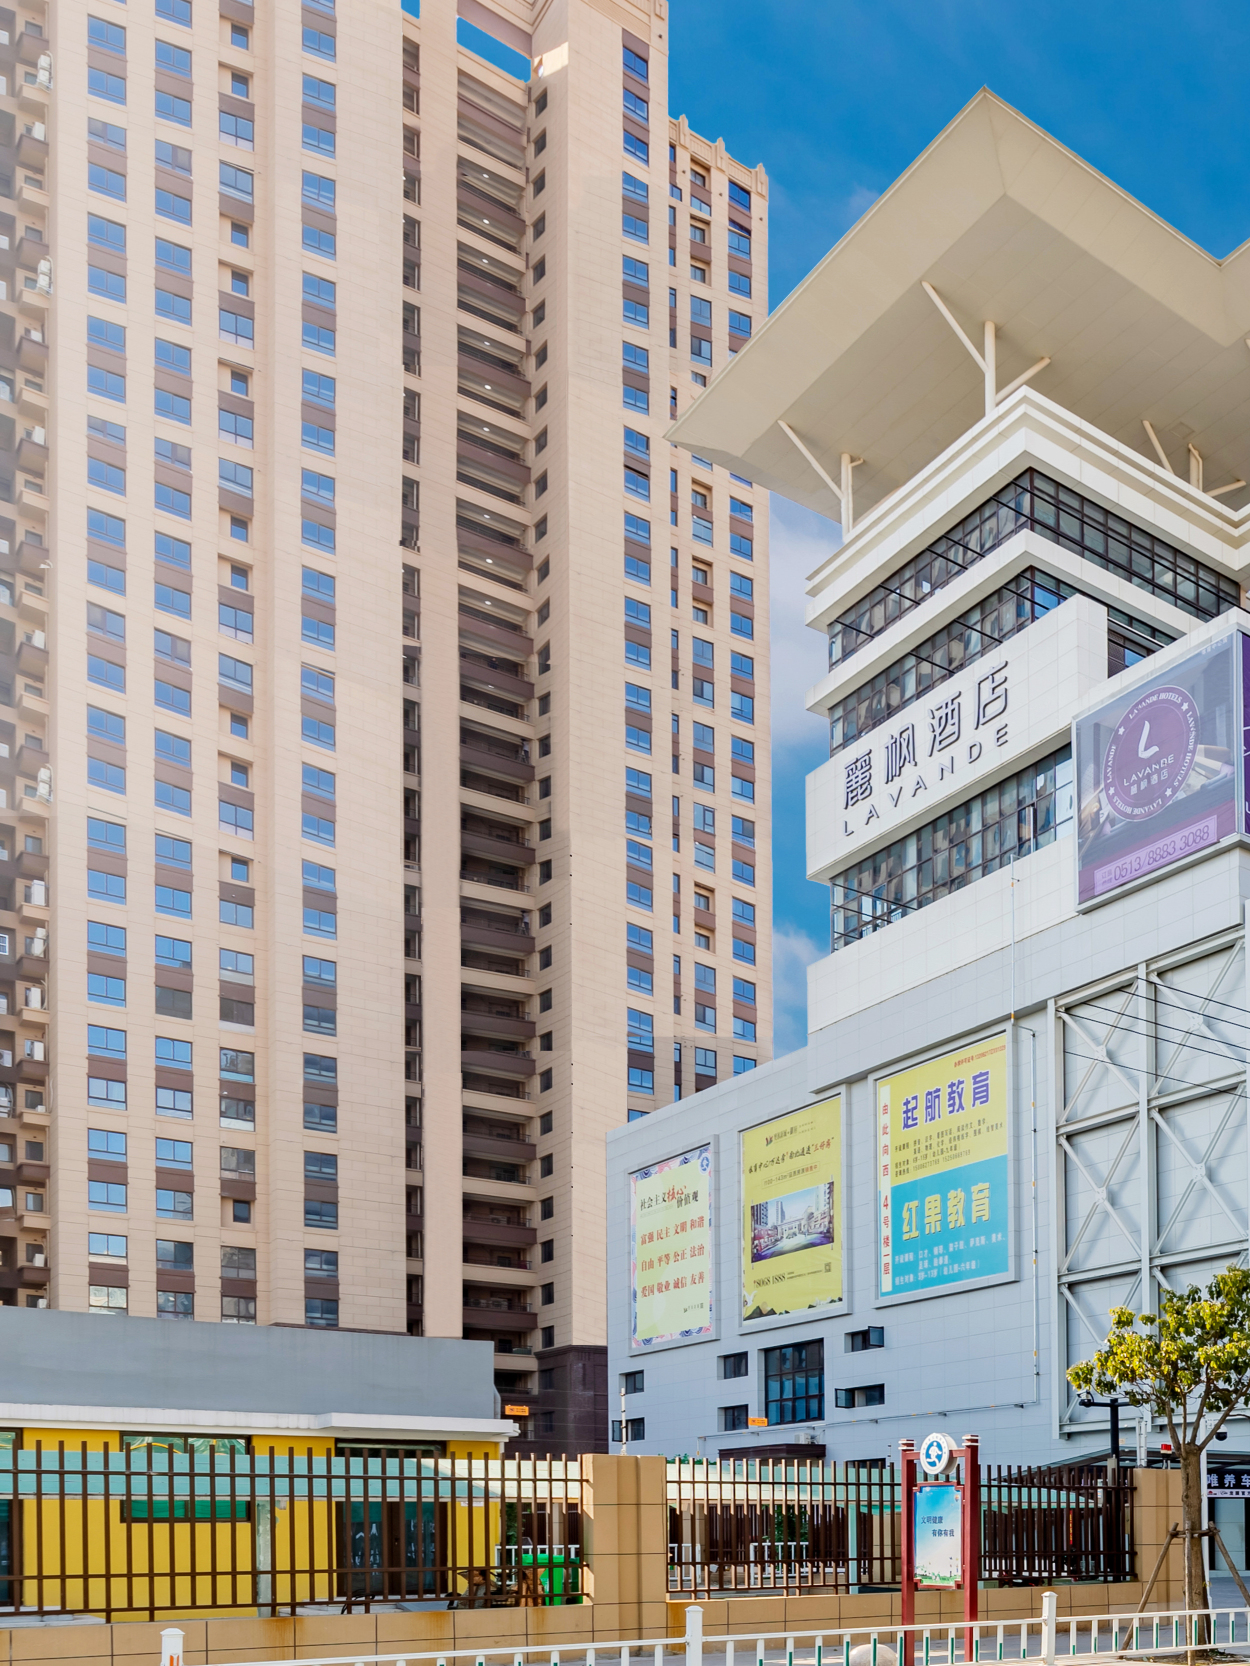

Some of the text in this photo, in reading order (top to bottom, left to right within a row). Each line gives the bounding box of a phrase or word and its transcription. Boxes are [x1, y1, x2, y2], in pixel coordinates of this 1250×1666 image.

[843, 660, 1009, 810] 麗枫酒店
[842, 723, 1009, 837] LAVANDE
[1123, 754, 1175, 787] LAVANDE
[1179, 825, 1210, 852] 3088
[902, 1070, 990, 1130] 起航教育
[640, 1185, 699, 1211] 社会主义核心价值观
[902, 1182, 990, 1241] 红果教育
[640, 1215, 705, 1246] 富强 民主 文明 和谐
[641, 1244, 705, 1272] 自由 平等 公正 法治
[641, 1271, 705, 1298] 爱国 敬业 诚信 友善
[920, 1515, 944, 1525] 文明健康
[931, 1528, 955, 1538] 有你有我
